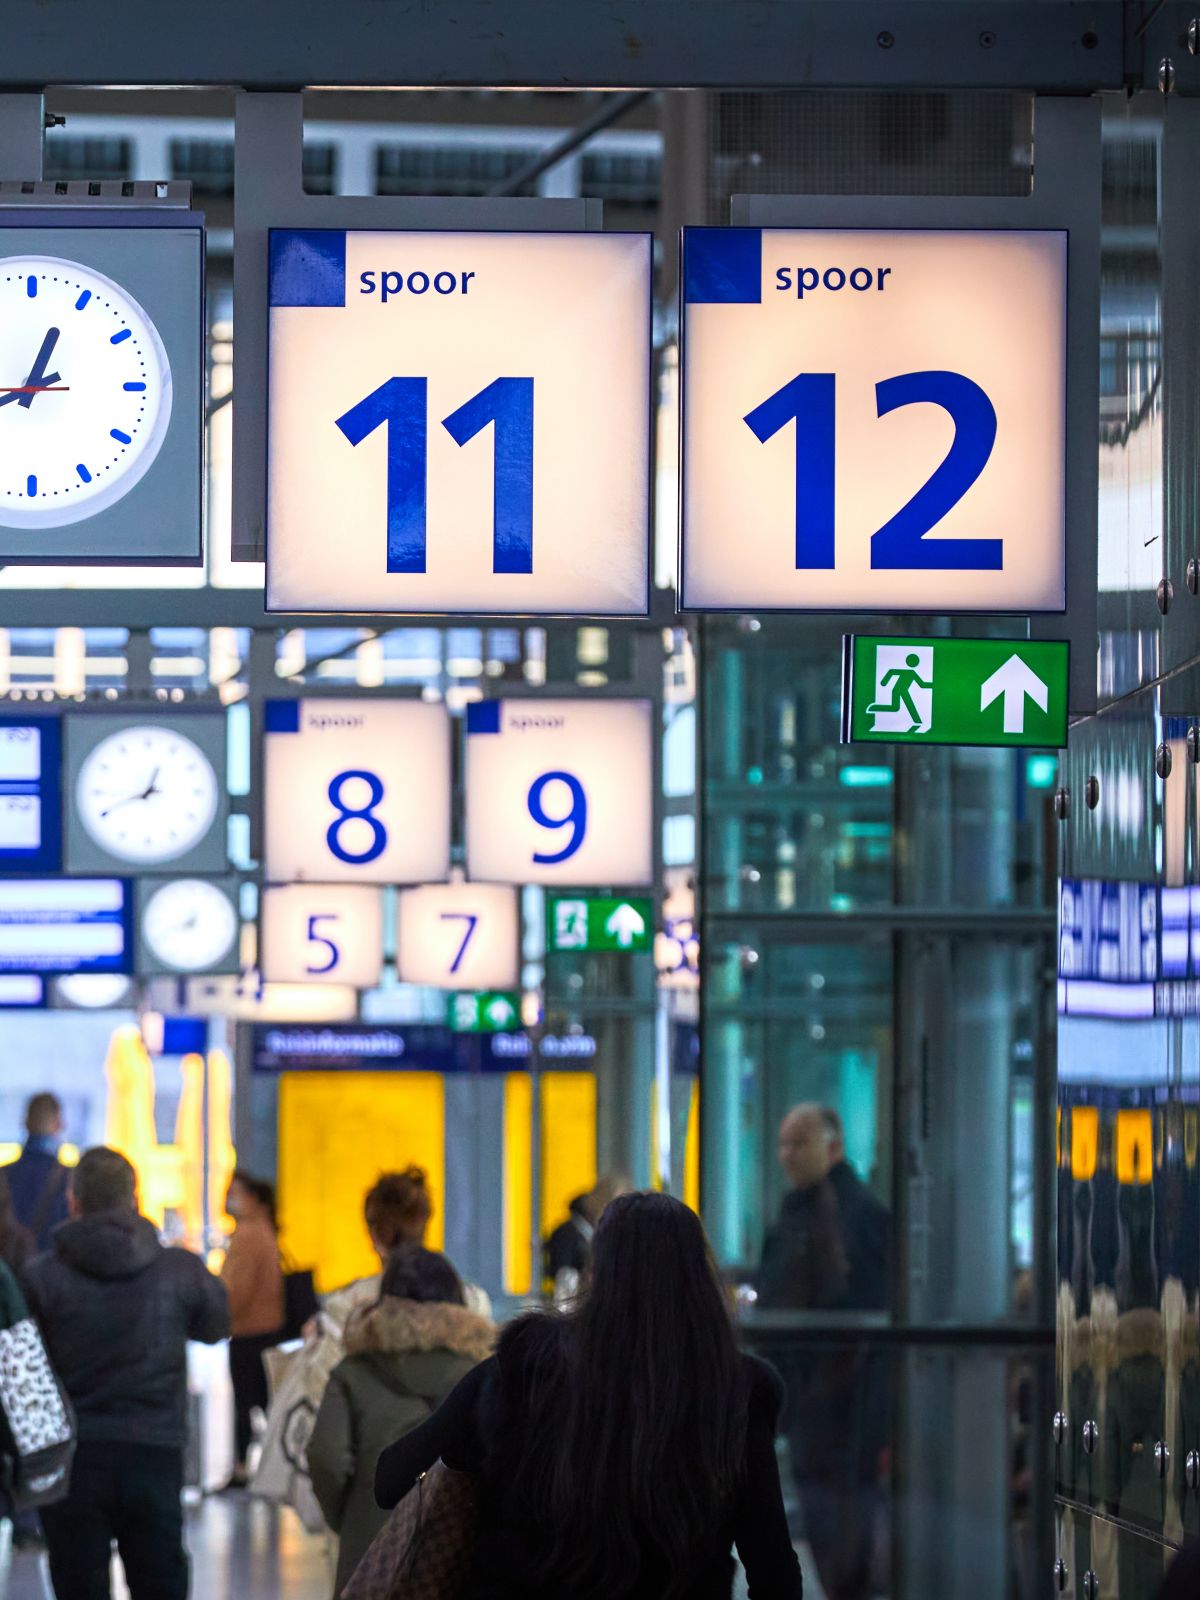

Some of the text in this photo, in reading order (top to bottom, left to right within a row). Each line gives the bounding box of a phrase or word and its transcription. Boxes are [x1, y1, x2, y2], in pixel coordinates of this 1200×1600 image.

[360, 271, 475, 303] spoor
[776, 268, 891, 299] spoor
[335, 377, 534, 574] 11
[743, 371, 1003, 570] 12
[327, 770, 387, 865] 8
[528, 771, 587, 864] 9
[307, 916, 339, 974] 5
[441, 914, 477, 974] 7
